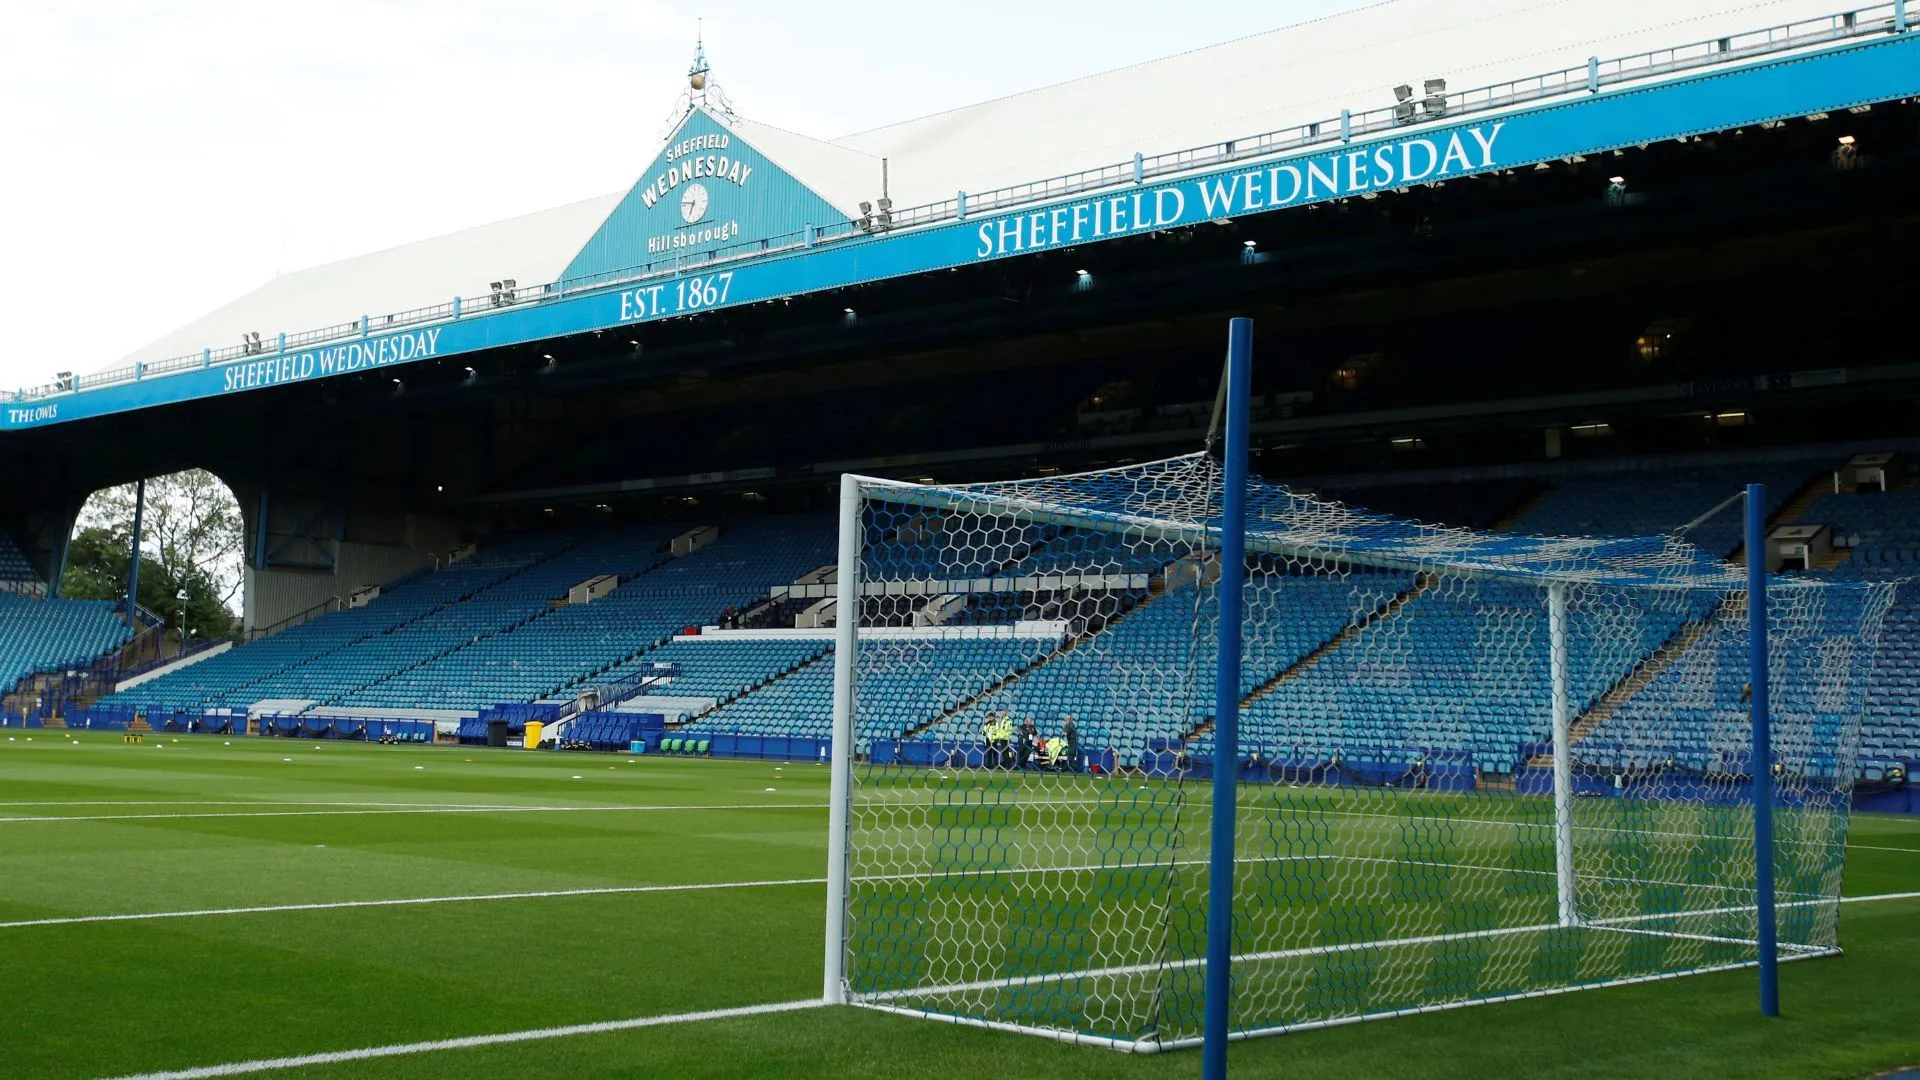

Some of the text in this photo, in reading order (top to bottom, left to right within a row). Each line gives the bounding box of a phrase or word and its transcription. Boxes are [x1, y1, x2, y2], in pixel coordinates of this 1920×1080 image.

[666, 134, 728, 163] SHEFFIELD
[641, 155, 752, 209] WEDNESDAY
[977, 122, 1504, 257] SHEFFIELD WEDNESDAY
[648, 220, 738, 253] Hillsborough
[620, 272, 734, 321] EST. 1867
[224, 328, 441, 391] SHEFFIELD WEDNESDAY
[8, 403, 58, 423] THE OWLS
